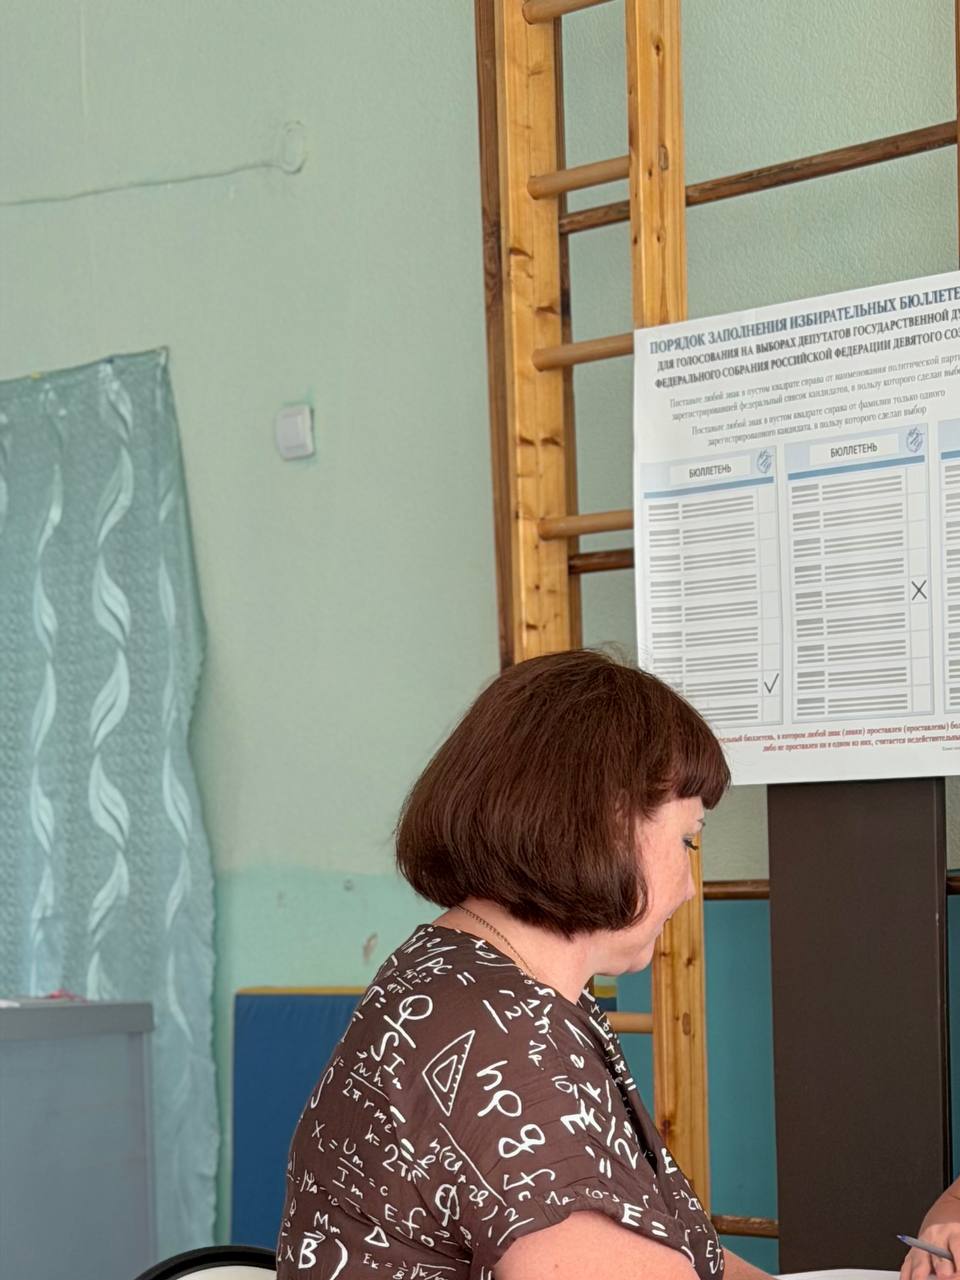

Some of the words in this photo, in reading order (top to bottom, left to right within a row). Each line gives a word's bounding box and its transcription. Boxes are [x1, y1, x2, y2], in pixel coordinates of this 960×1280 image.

[650, 332, 705, 354] ПОРЯДОК
[708, 318, 786, 343] ЗАПОЛНЕНИЯ
[790, 299, 896, 329] ИЗБИРАТЕЛЬНЫХ
[657, 358, 674, 372] ДЛЯ
[676, 347, 738, 366] ГОЛОСОВАНИЯ
[741, 344, 753, 355] НА
[756, 337, 795, 353] ВЫБОРАХ
[798, 327, 850, 345] ДЕПУТАТОВ
[853, 308, 948, 336] ГОСУДАРСТВЕННОЙ
[654, 369, 720, 389] ФЕДЕРАЛЬНОГО
[722, 360, 768, 377] СОБРАНИЯ
[771, 349, 832, 369] РОССИЙСКОЙ
[834, 340, 890, 358] ФЕДЕРАЦИИ
[893, 331, 942, 348] ДЕВЯТОГО
[689, 464, 732, 479] БЮЛЛЕТЕНЬ
[830, 443, 878, 458] БЮЛЛЕТЕНЬ
